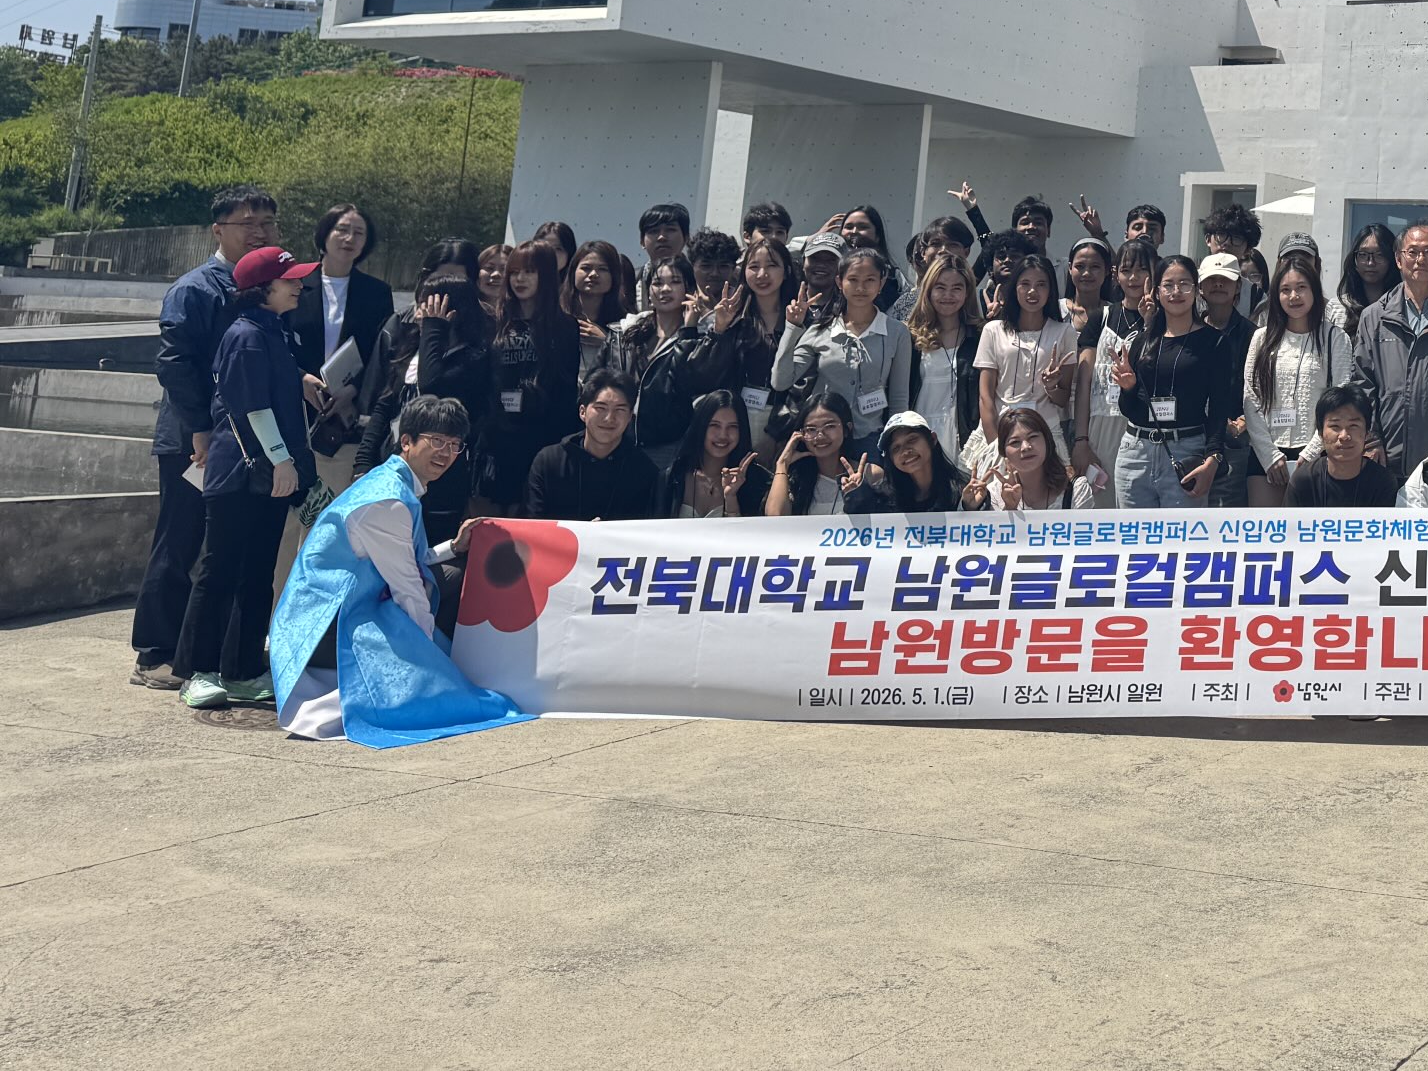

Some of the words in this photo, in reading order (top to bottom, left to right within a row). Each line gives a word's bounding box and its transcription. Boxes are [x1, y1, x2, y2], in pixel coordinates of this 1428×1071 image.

[819, 526, 896, 550] 2026년
[904, 523, 1017, 549] 전북대학교
[1026, 520, 1209, 547] 남원글로벌캠퍼스
[1219, 519, 1288, 544] 신입생
[589, 554, 872, 616] 전북대학교
[890, 547, 1351, 613] 남원글로컬캠퍼스
[828, 615, 1148, 677] 남원방문을
[809, 687, 843, 707] 일시
[860, 687, 906, 706] 2026.
[911, 687, 927, 706] 5.
[933, 685, 974, 706] 1.(금)
[1014, 685, 1049, 705] 장소
[1067, 683, 1121, 704] 남원시
[1127, 682, 1163, 703] 일원
[1202, 682, 1239, 702] 주최
[1297, 682, 1342, 701] 남원시
[1374, 682, 1412, 702] 주관
